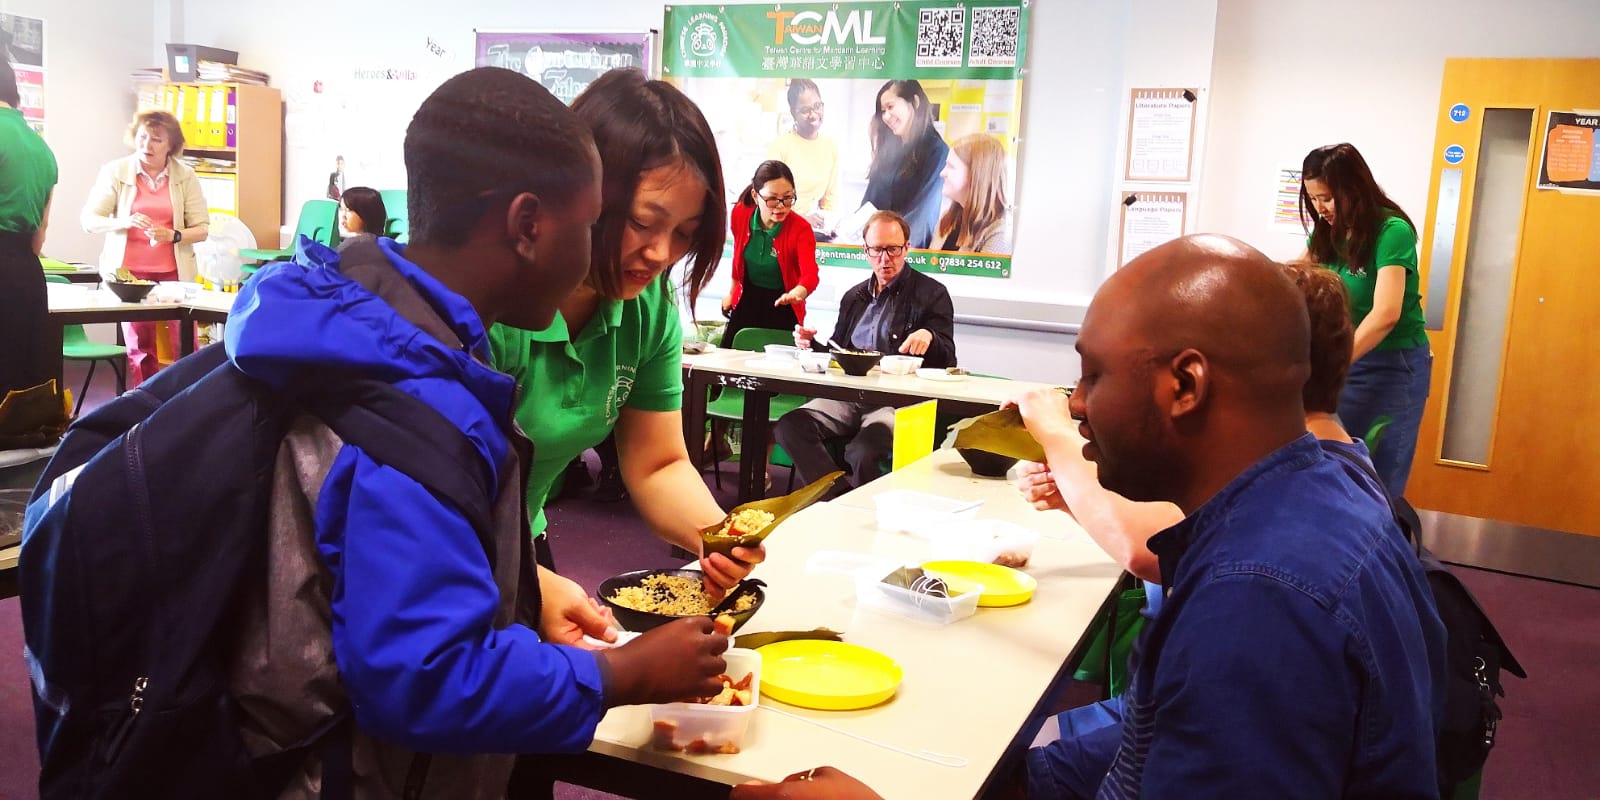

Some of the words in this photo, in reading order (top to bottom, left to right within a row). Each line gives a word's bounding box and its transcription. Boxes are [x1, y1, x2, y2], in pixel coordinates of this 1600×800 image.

[425, 36, 446, 58] Year
[765, 46, 788, 54] Taiwan
[789, 46, 812, 54] Centre
[823, 46, 855, 54] Mandarin
[856, 46, 886, 55] Learning
[1575, 118, 1598, 126] YEAR
[939, 257, 965, 267] 07834
[967, 259, 983, 269] 254
[985, 261, 1001, 270] 612
